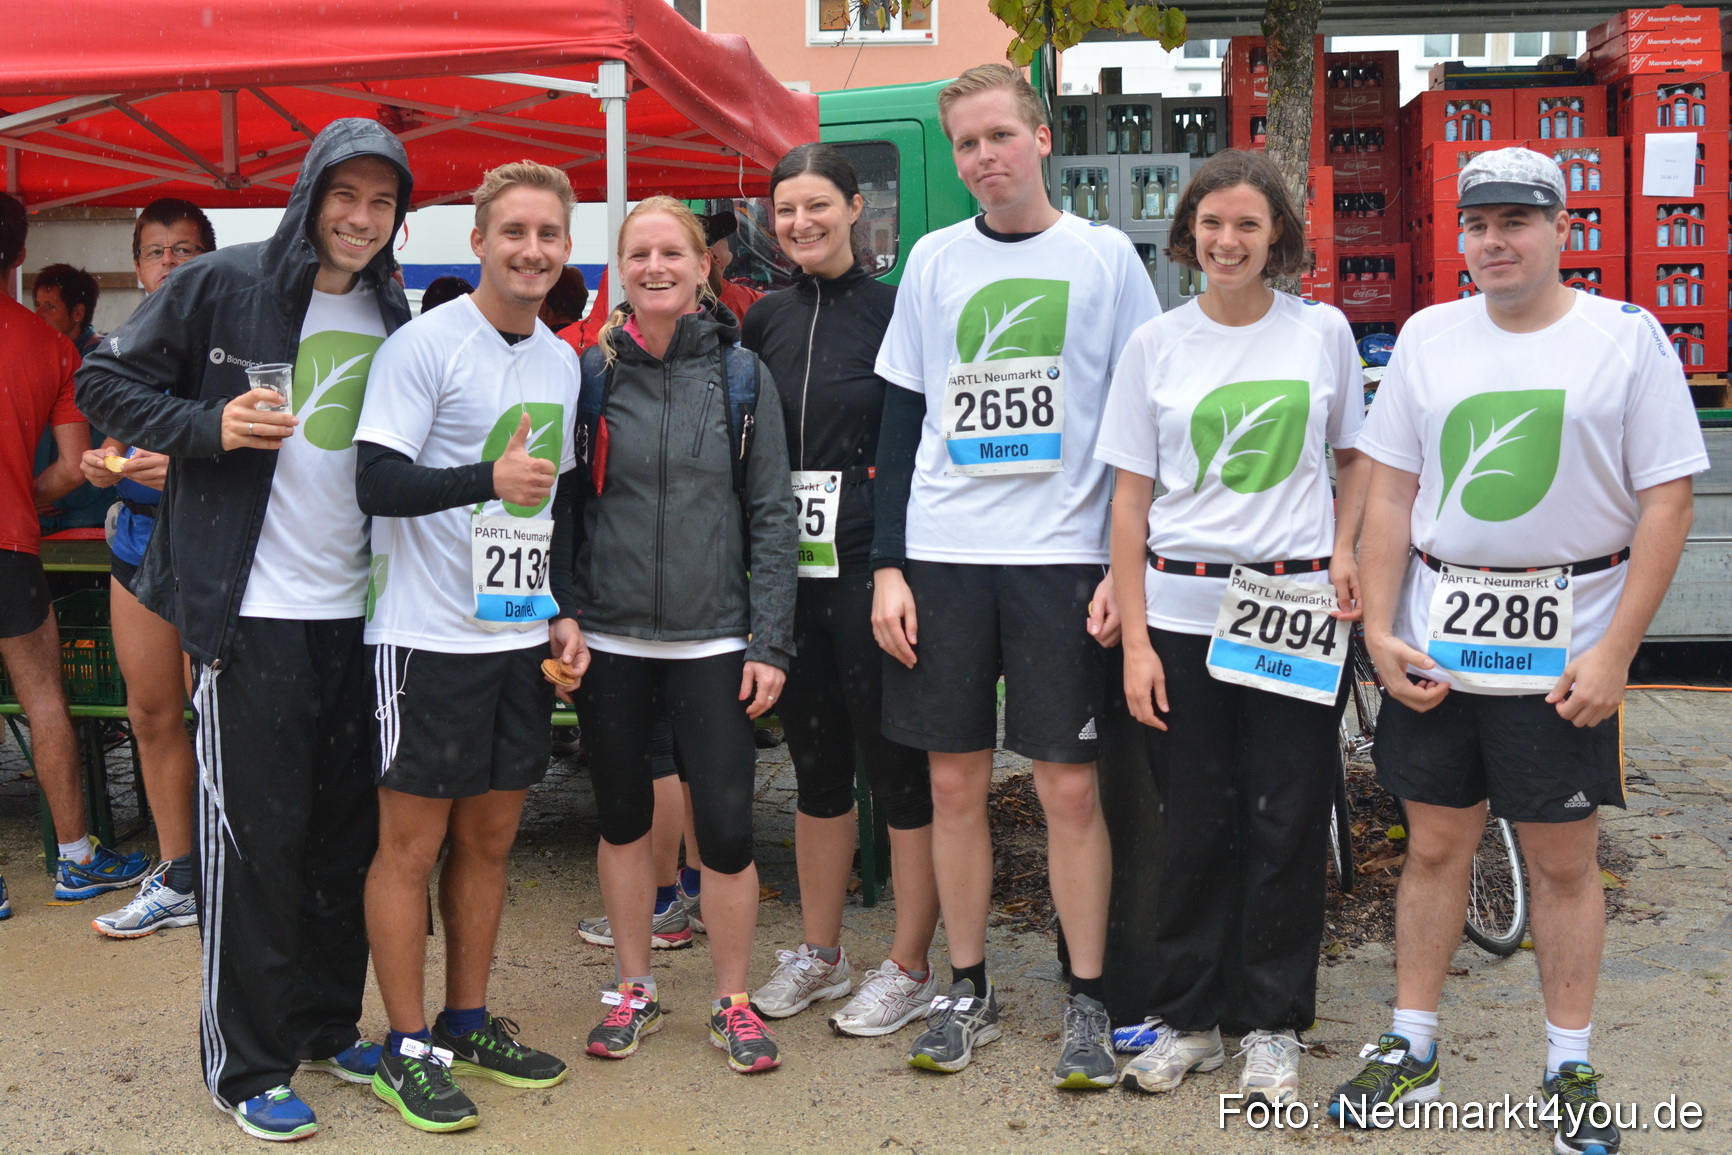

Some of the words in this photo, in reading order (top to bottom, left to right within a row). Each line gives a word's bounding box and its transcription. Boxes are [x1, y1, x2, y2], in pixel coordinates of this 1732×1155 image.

[947, 374, 982, 387] PARTL
[984, 369, 1042, 383] Neumarkt
[954, 385, 1054, 432] 2658
[979, 442, 1029, 459] Marco
[475, 527, 511, 540] PARTL
[485, 545, 550, 590] 2135
[1231, 576, 1273, 598] PARTL
[1274, 589, 1333, 607] Neumarkt
[1440, 573, 1481, 585] PARTL
[1484, 577, 1549, 589] Neumarkt
[1442, 590, 1559, 641] 2286
[1228, 599, 1338, 656] 2094
[1254, 654, 1293, 677] Aute
[1460, 649, 1533, 670] Michael
[1078, 732, 1098, 740] adidas
